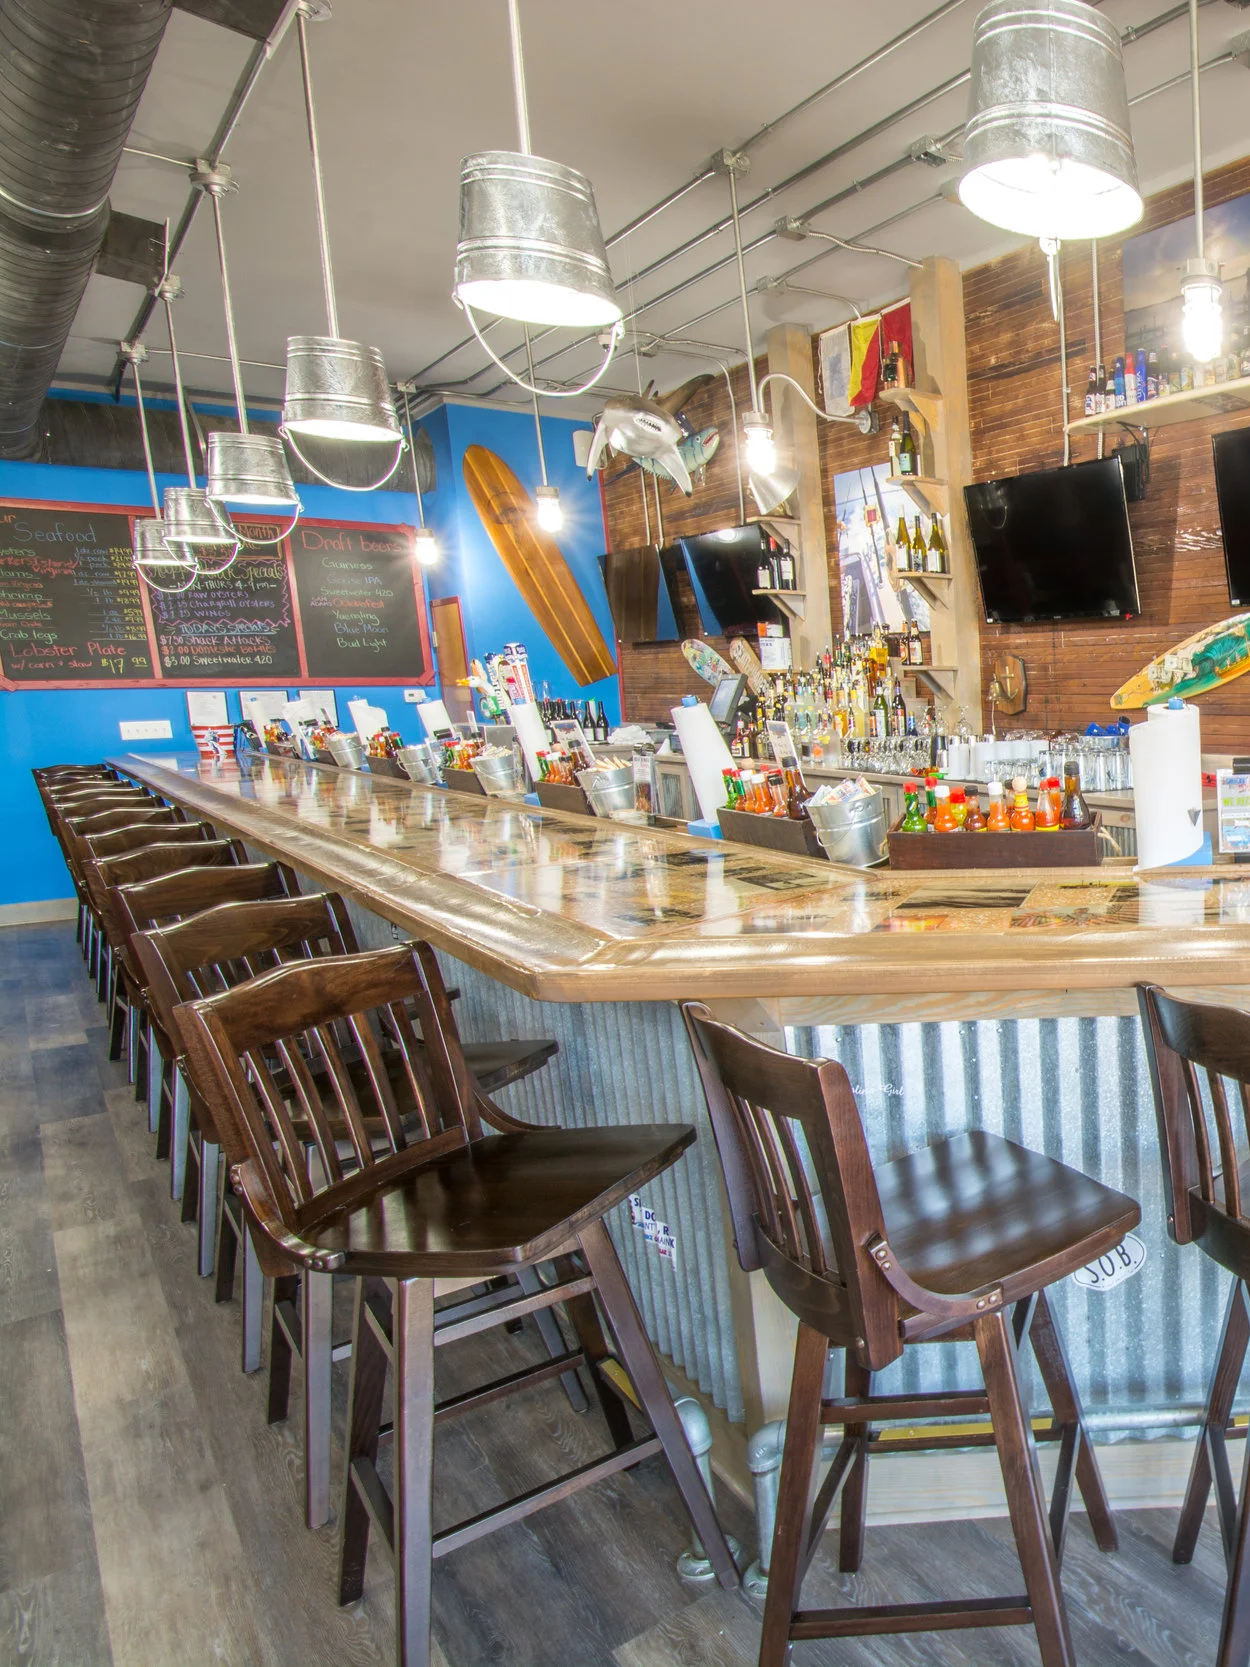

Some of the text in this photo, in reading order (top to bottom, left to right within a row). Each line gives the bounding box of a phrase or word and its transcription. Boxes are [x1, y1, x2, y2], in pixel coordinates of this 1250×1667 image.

[13, 521, 97, 543] Seafood
[301, 530, 402, 553] Draft beers
[333, 622, 390, 634] Blue Moon
[0, 629, 58, 645] Crab legs
[336, 637, 361, 649] Bud
[9, 641, 127, 658] Lobster Plate
[28, 660, 55, 669] corn
